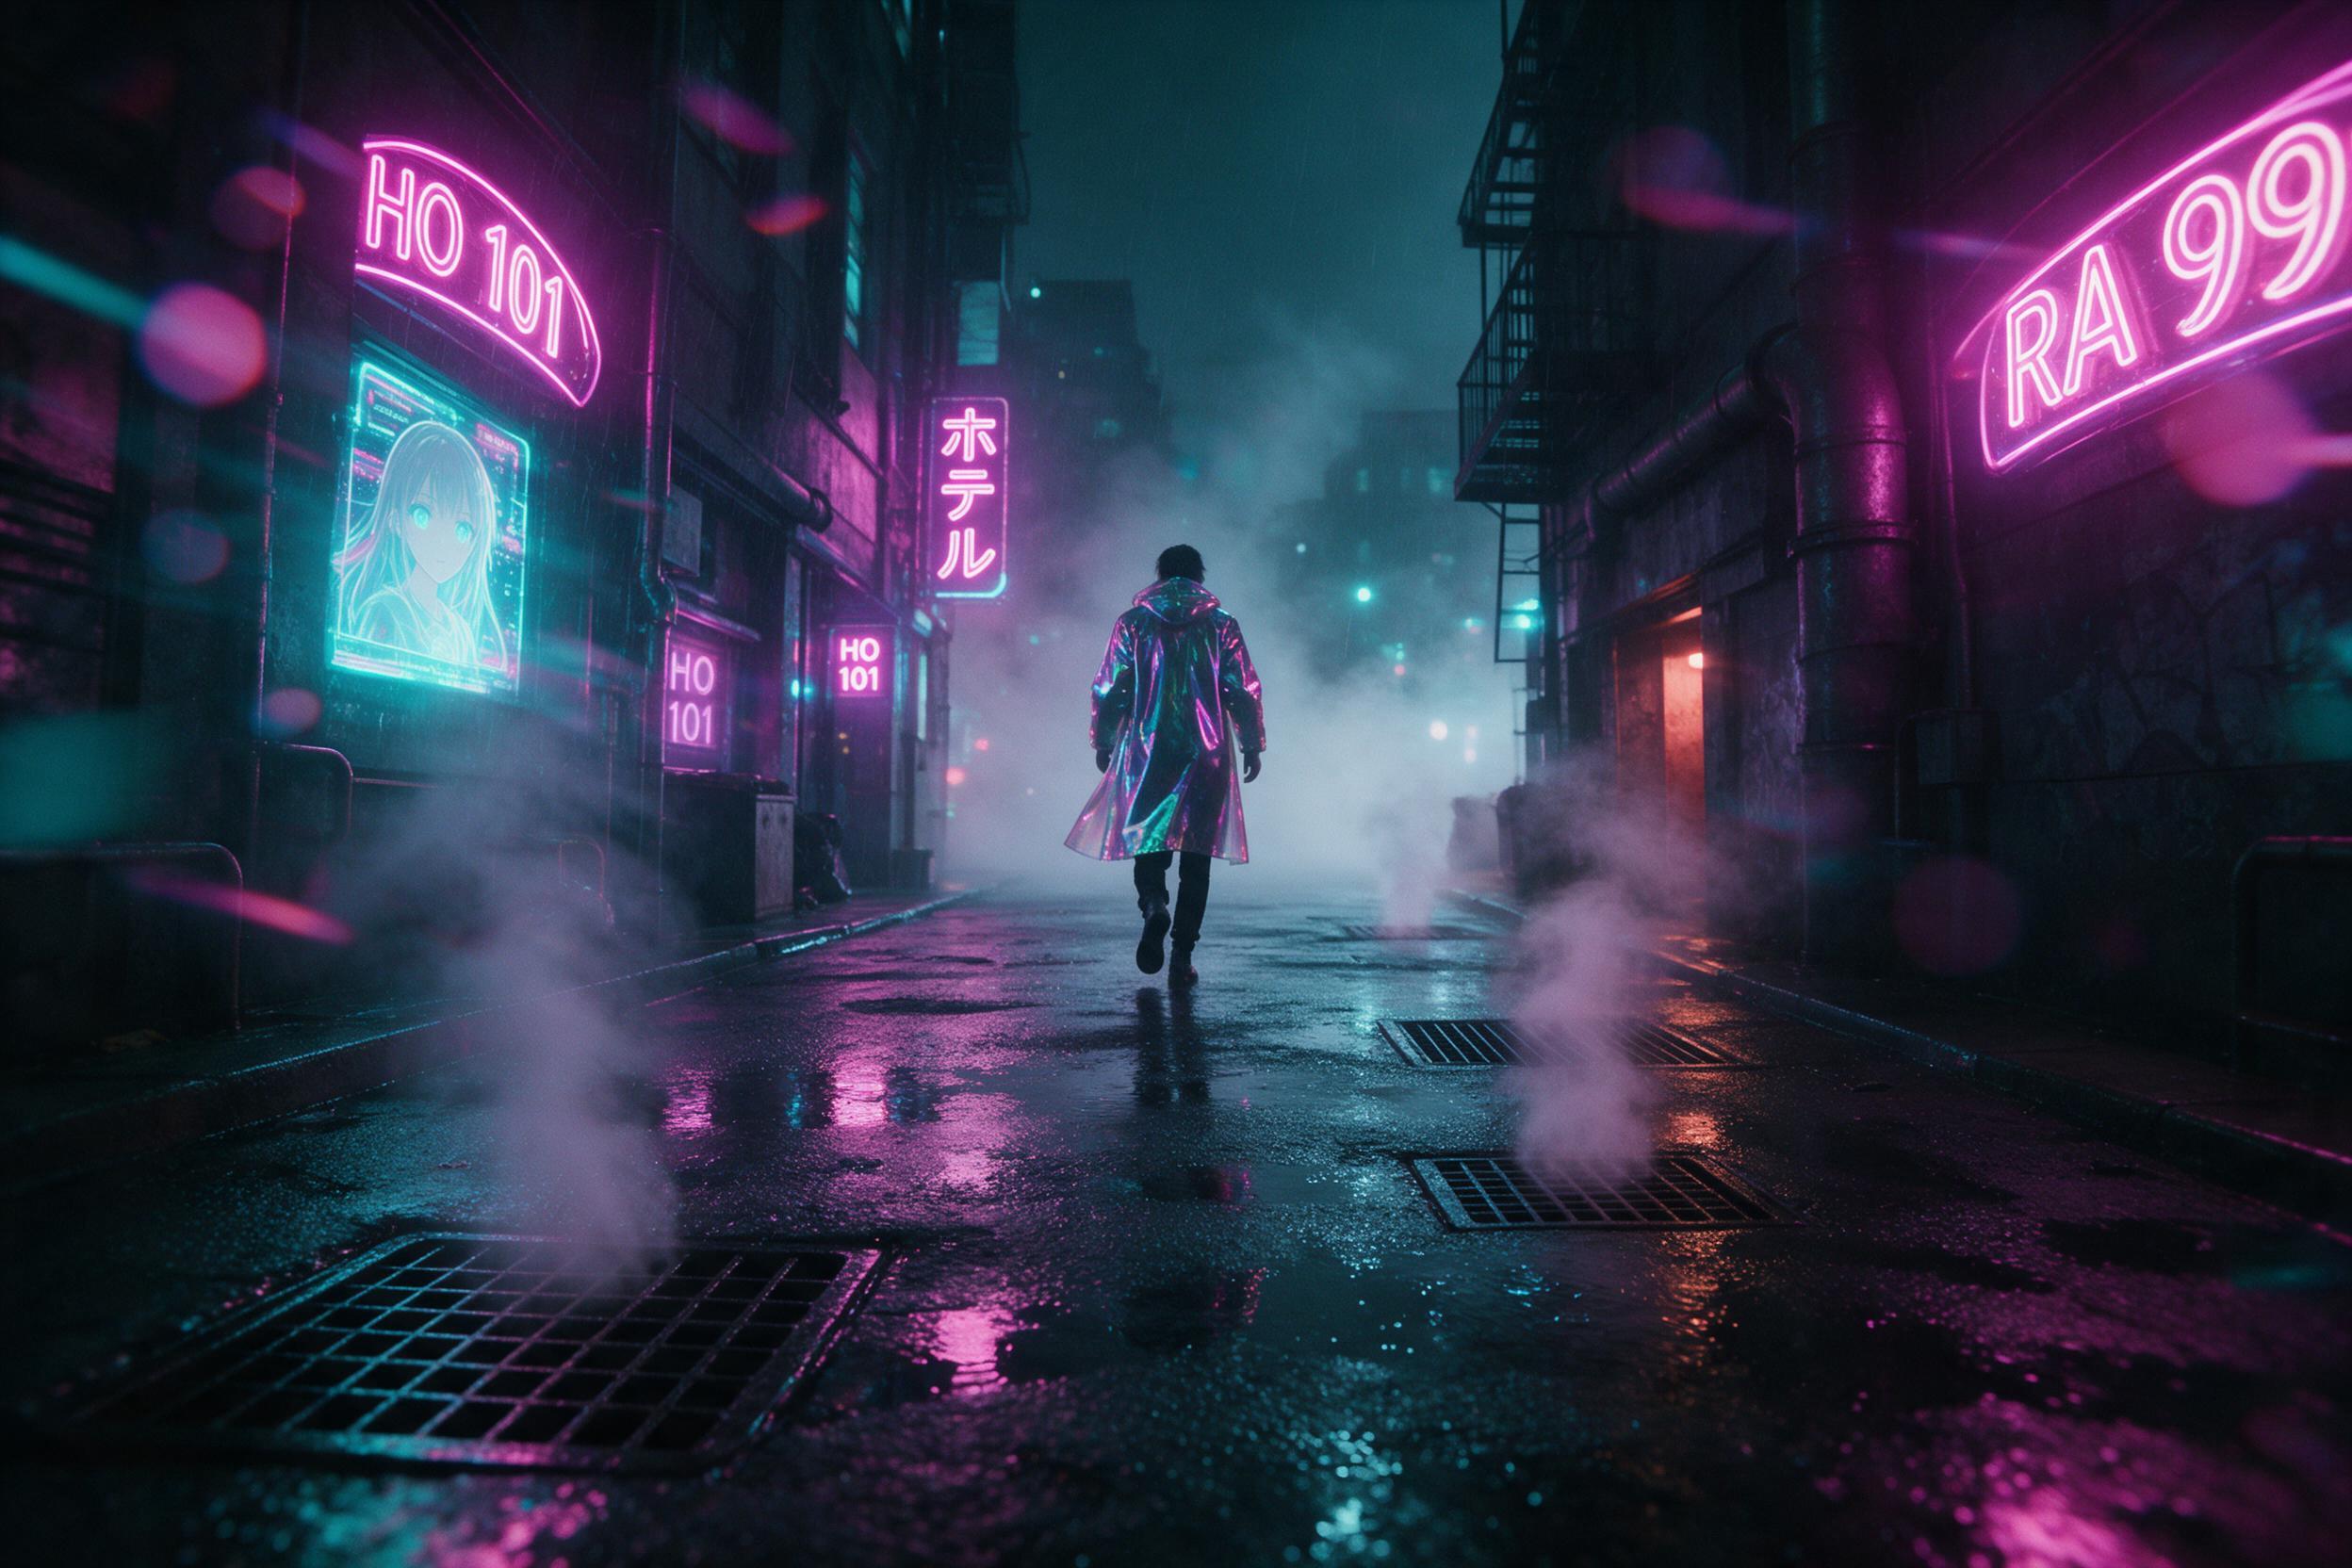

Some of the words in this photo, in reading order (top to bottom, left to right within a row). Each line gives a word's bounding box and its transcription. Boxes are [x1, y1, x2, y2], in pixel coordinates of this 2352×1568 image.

[365, 154, 464, 277] HO
[484, 224, 563, 359] 101
[2005, 243, 2138, 429] RA
[2162, 121, 2346, 337] 99
[936, 406, 997, 580] ホテル
[840, 637, 881, 662] HO
[669, 651, 715, 696] HO
[838, 665, 879, 693] 101
[668, 700, 713, 745] 101
